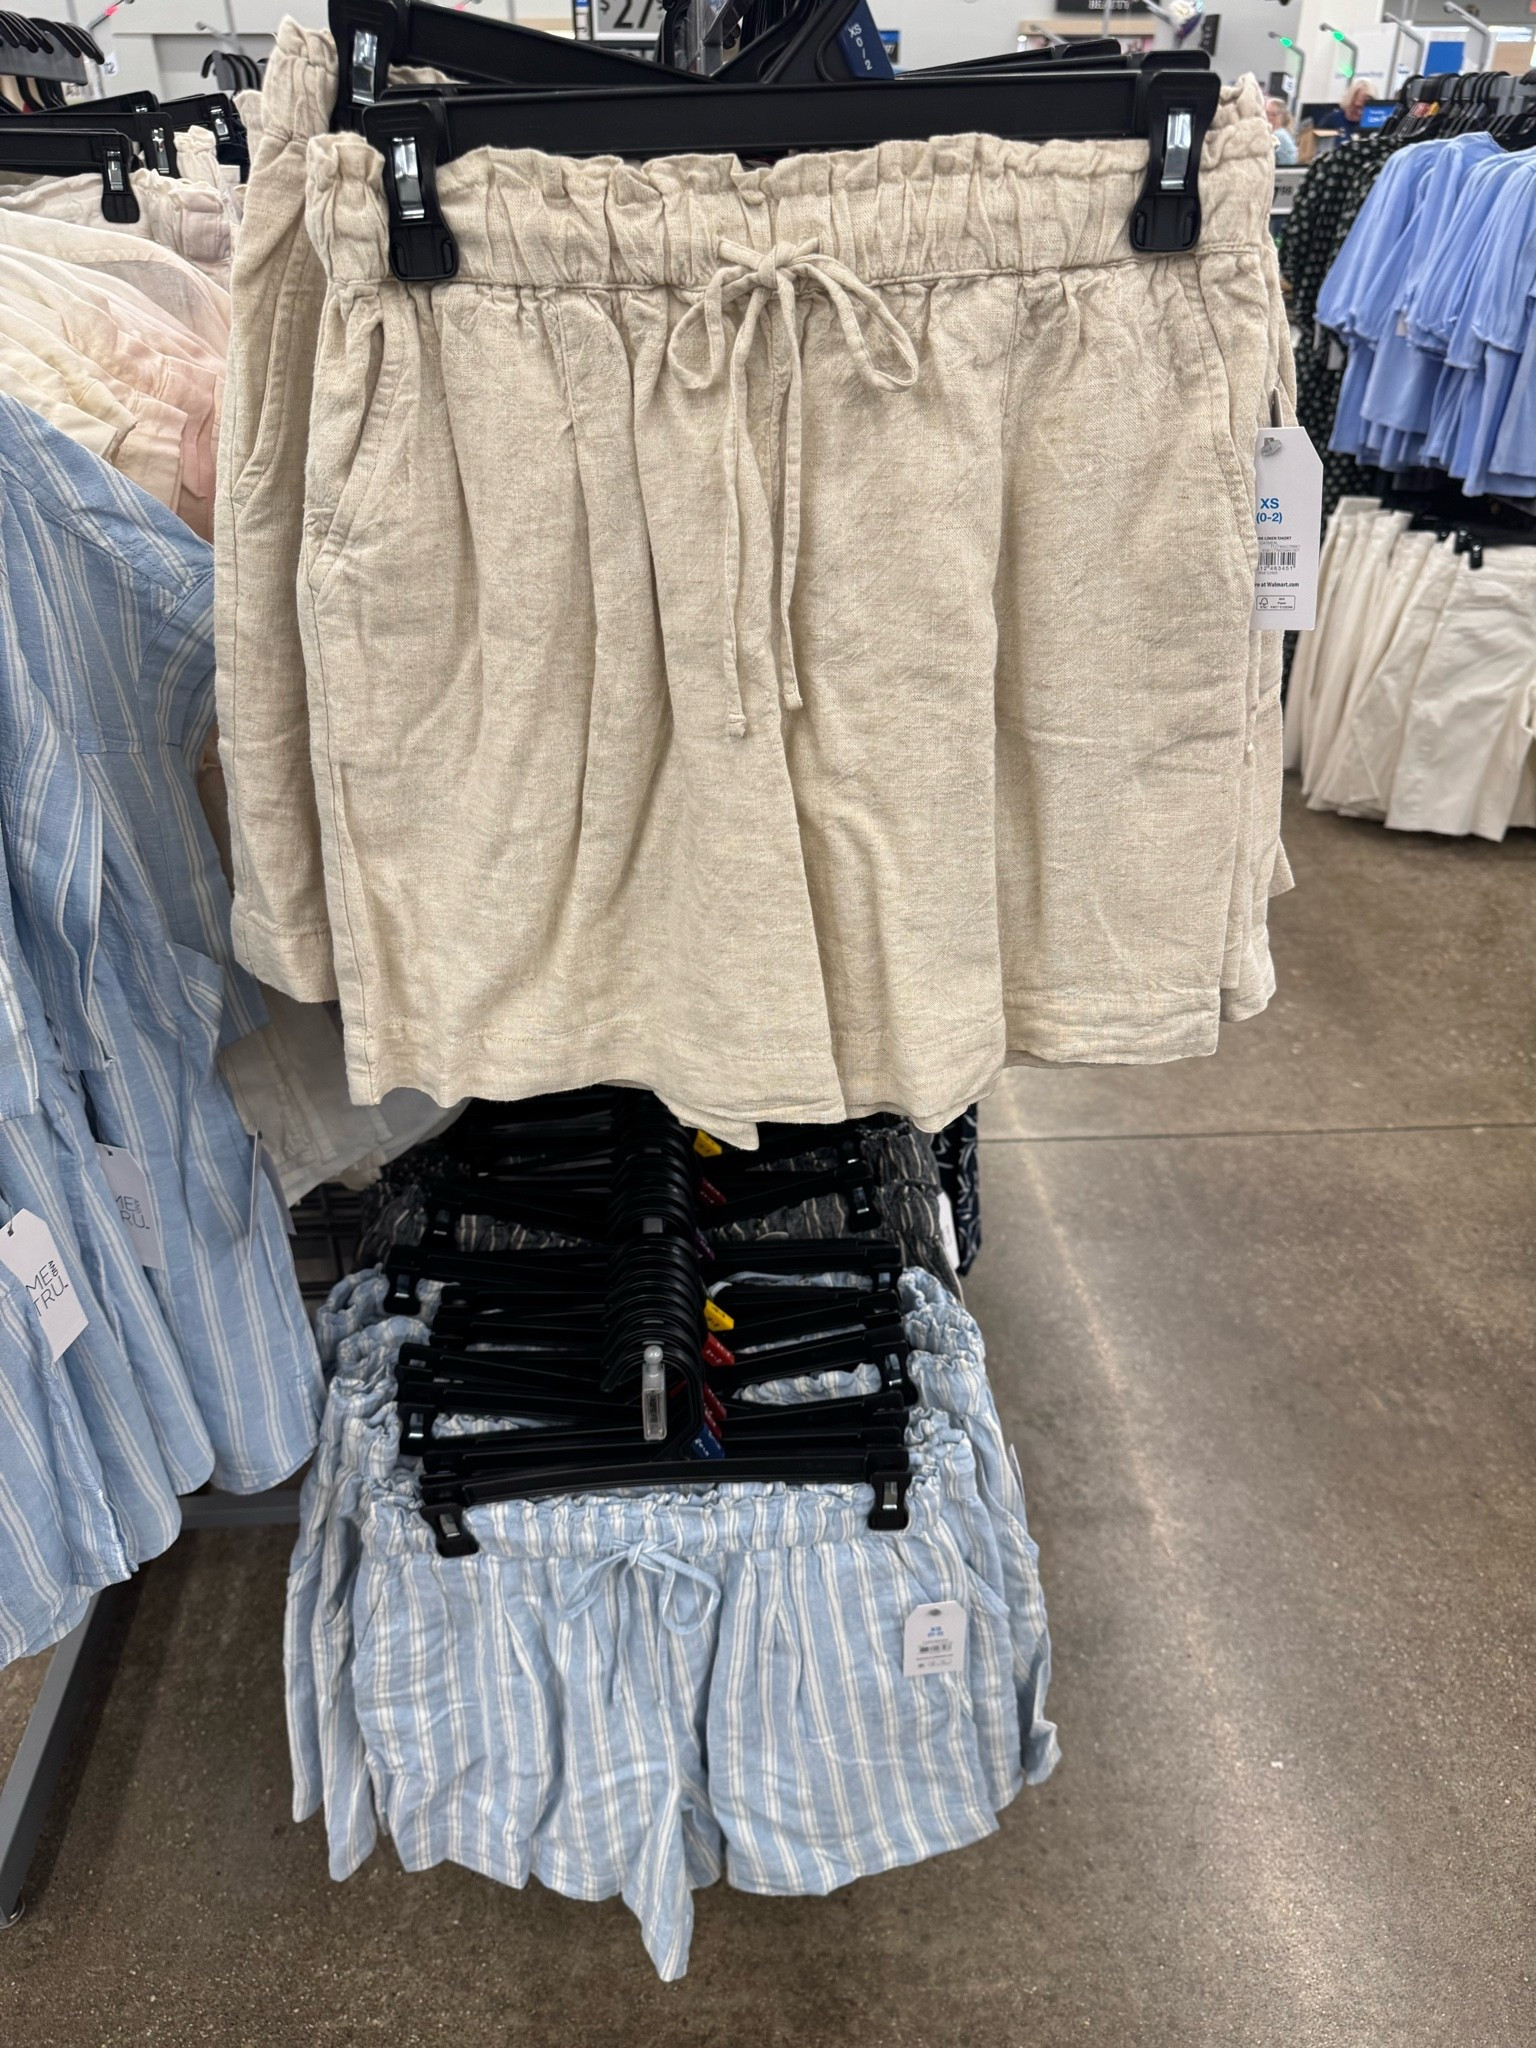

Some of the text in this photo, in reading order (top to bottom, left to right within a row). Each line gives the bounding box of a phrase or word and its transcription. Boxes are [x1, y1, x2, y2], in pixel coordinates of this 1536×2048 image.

[848, 23, 862, 38] XS
[1260, 498, 1280, 510] XS
[1256, 512, 1283, 524] (0-2)
